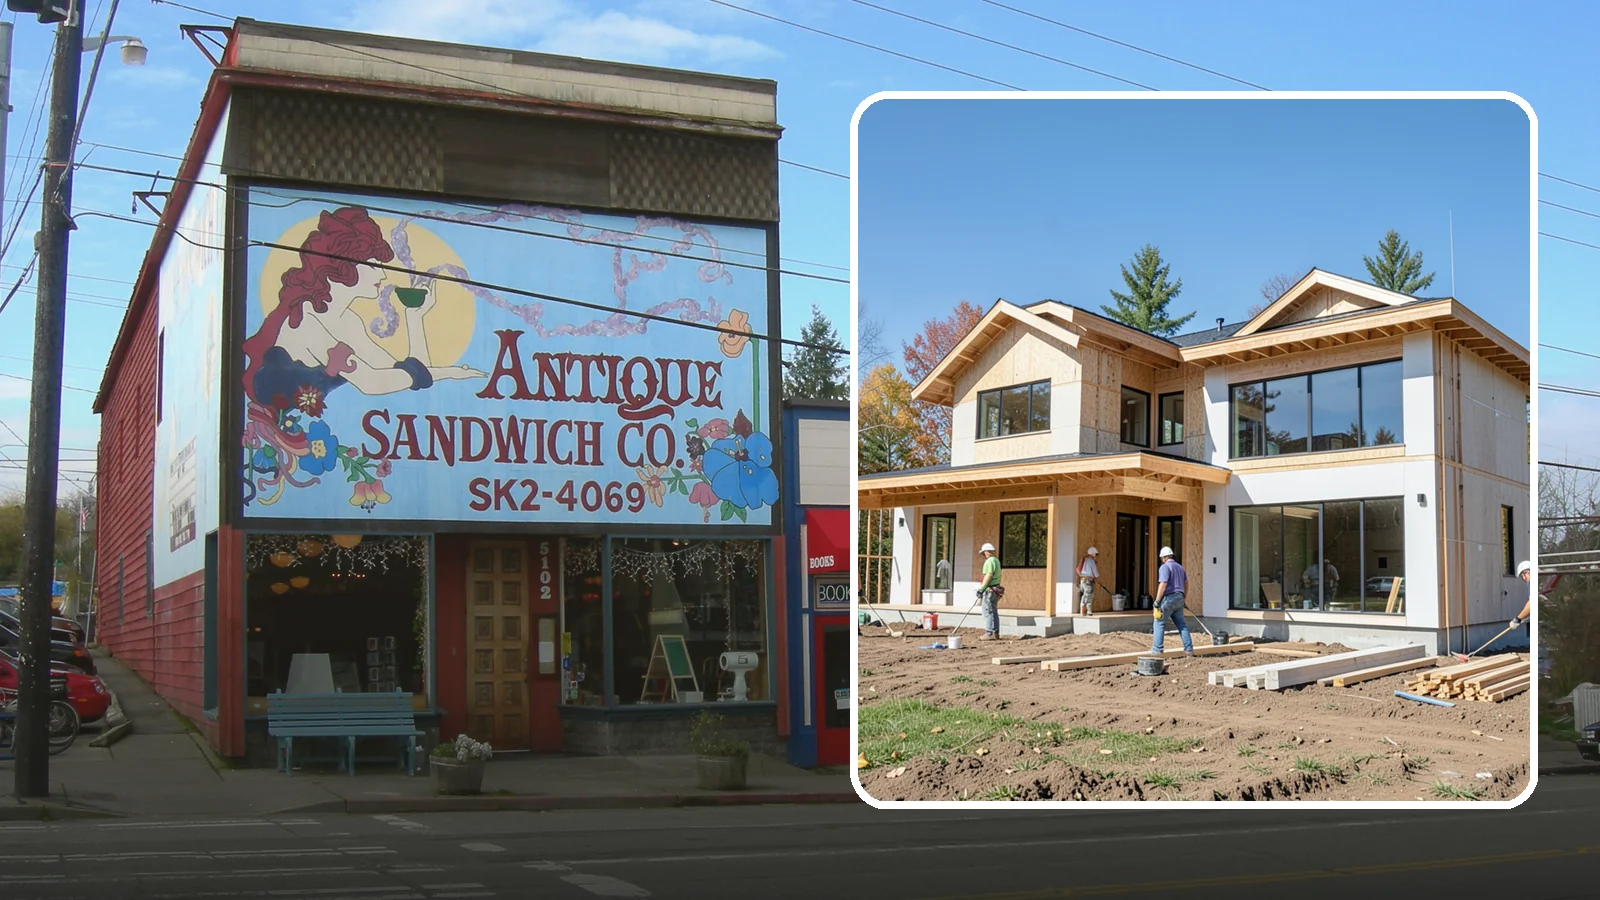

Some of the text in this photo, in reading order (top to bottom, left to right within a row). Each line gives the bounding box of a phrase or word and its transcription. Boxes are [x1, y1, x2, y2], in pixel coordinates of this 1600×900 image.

[477, 329, 722, 421] ANTIQUE
[362, 408, 685, 468] SANDWICH CO.
[469, 477, 645, 513] SK2-4069
[539, 541, 552, 600] 5102
[809, 554, 835, 569] BOOKS
